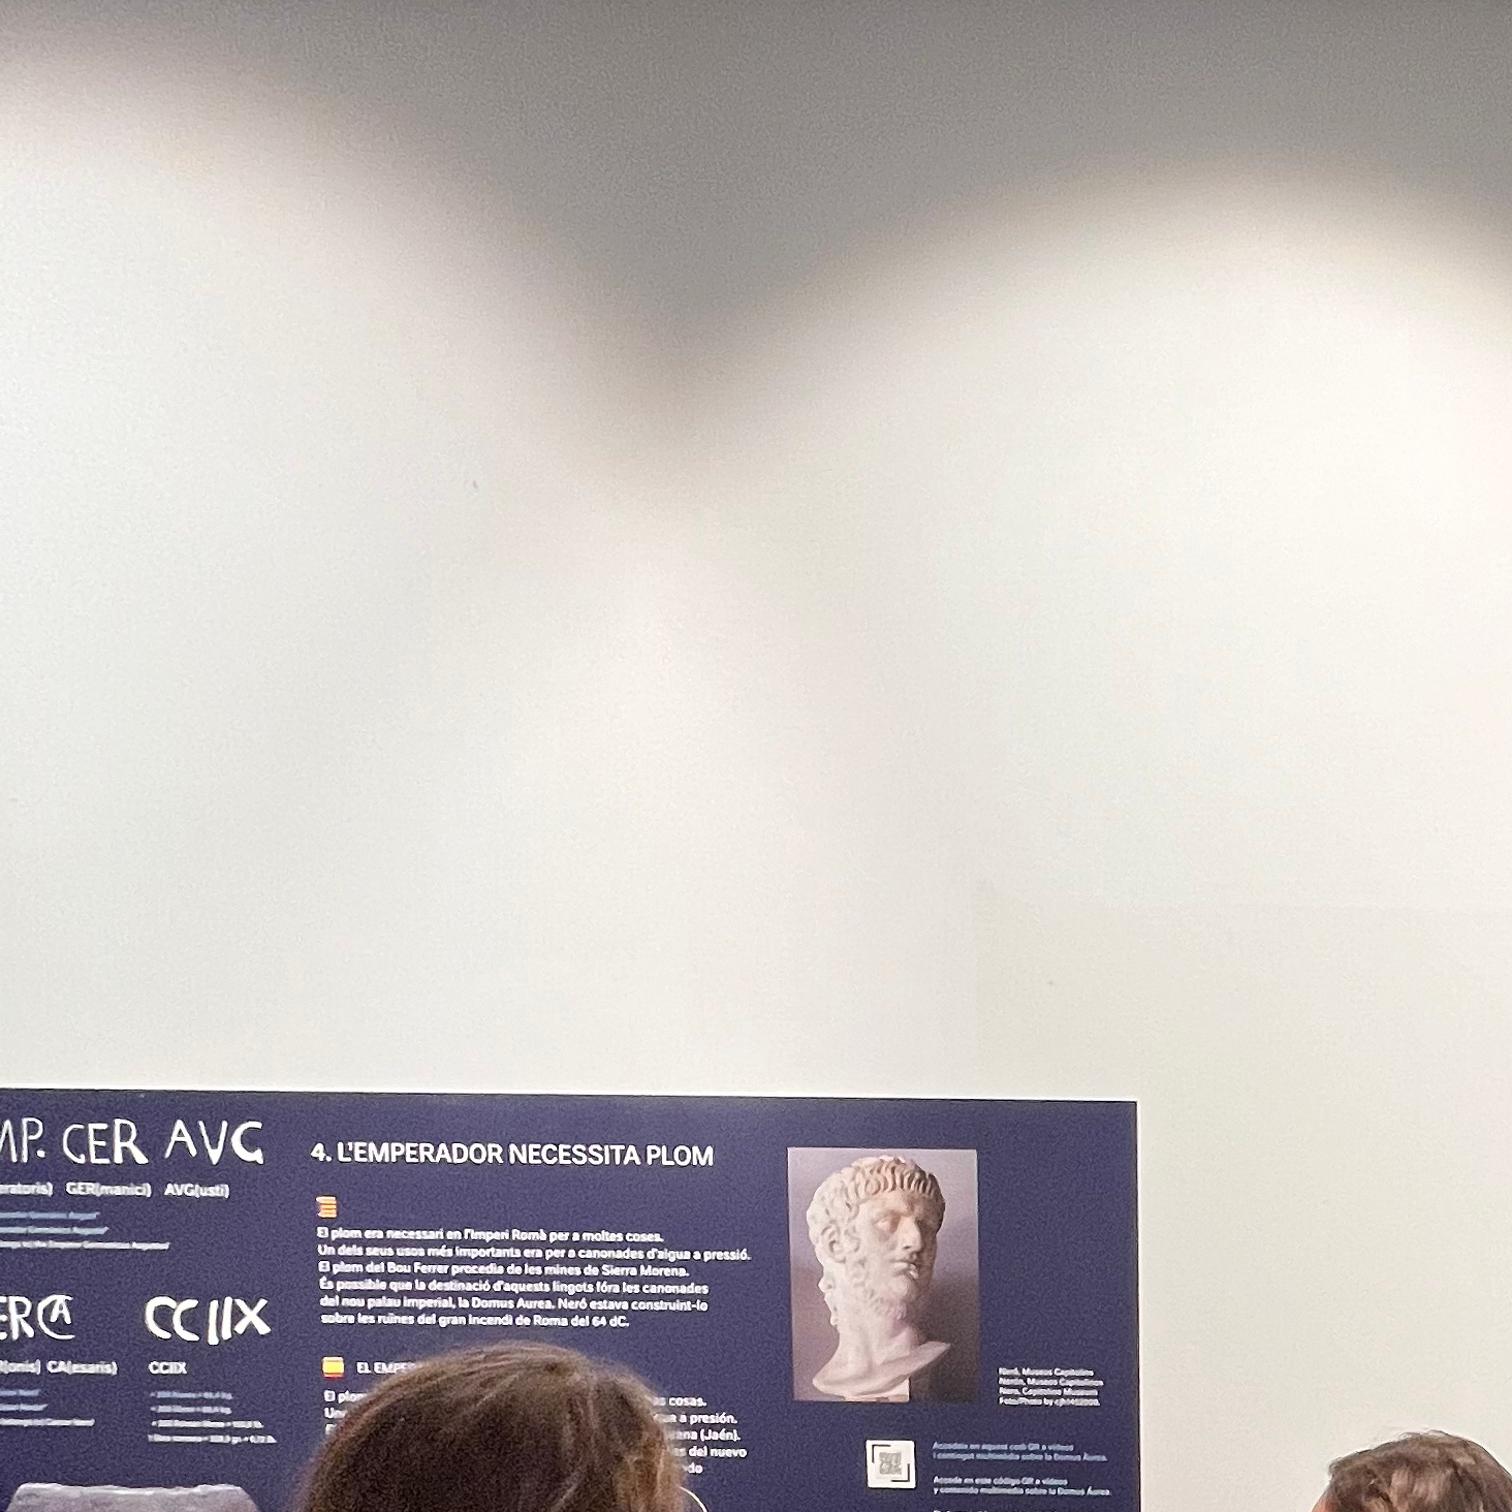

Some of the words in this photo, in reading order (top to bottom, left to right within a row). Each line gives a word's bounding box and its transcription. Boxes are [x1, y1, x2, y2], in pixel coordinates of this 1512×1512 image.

[311, 1143, 332, 1161] 4.
[338, 1142, 503, 1163] L'EMPERADOR
[509, 1144, 641, 1166] NECESSITA
[647, 1145, 713, 1166] PLOM
[364, 1230, 383, 1238] era
[387, 1262, 411, 1273] Bou
[428, 1279, 491, 1291] destinació
[668, 1396, 707, 1406] cosas.
[689, 1411, 737, 1425] presión.
[700, 1428, 741, 1442] (Jaén).
[688, 1446, 708, 1457] del
[710, 1448, 747, 1458] nuevo
